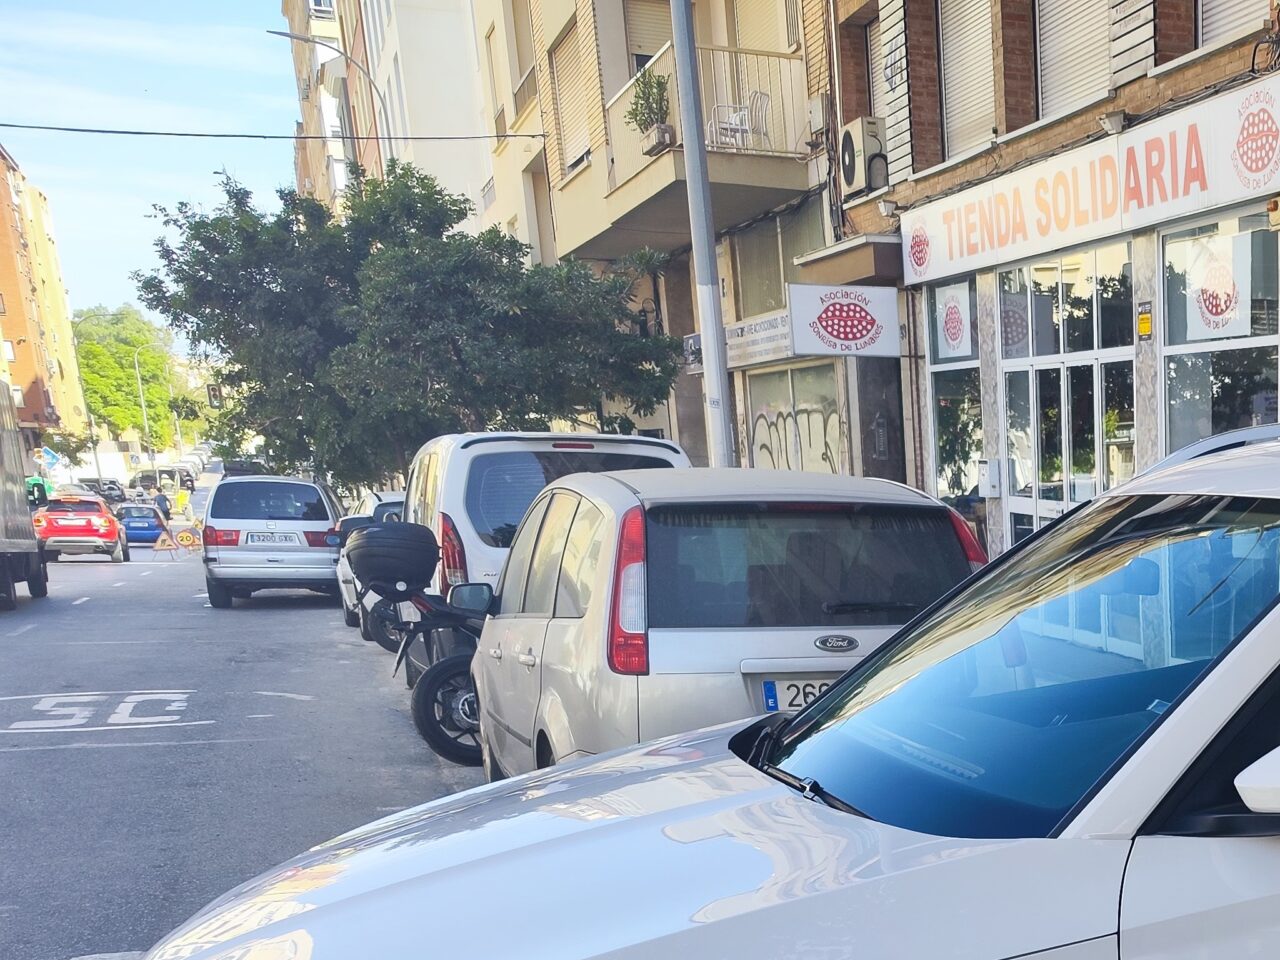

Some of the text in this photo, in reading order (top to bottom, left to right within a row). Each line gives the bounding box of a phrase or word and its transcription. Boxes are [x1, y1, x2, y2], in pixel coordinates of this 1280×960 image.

[942, 186, 1028, 261] TIENDA
[1034, 123, 1208, 238] SOLIDARIA
[256, 534, 276, 542] 3200
[826, 637, 849, 648] Ford
[768, 699, 775, 707] E
